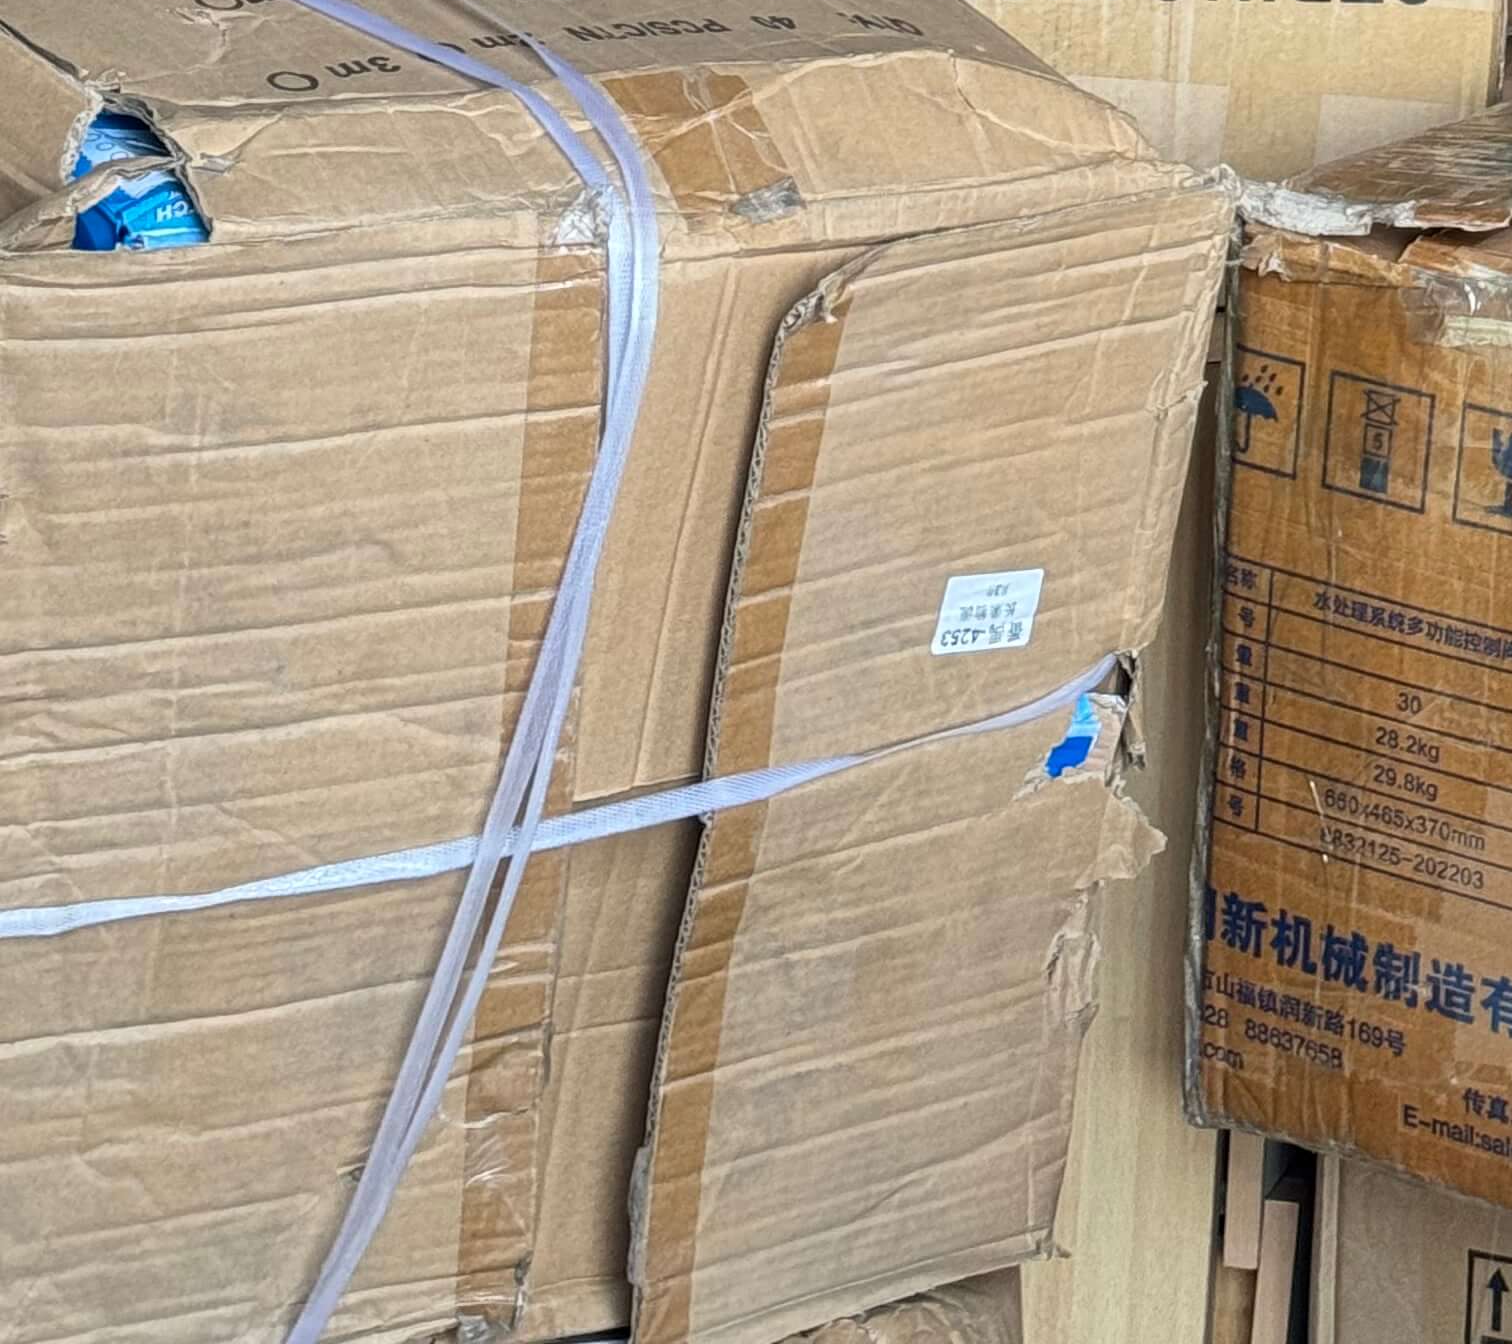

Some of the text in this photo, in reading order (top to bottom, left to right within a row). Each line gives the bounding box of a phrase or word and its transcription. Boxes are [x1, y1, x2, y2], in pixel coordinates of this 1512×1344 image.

[325, 55, 402, 79] 3m
[1396, 690, 1424, 716] 30
[1374, 726, 1441, 764] 28.2kg
[1372, 763, 1440, 803] 29.8kg
[1200, 1004, 1344, 1070] 28 88637658
